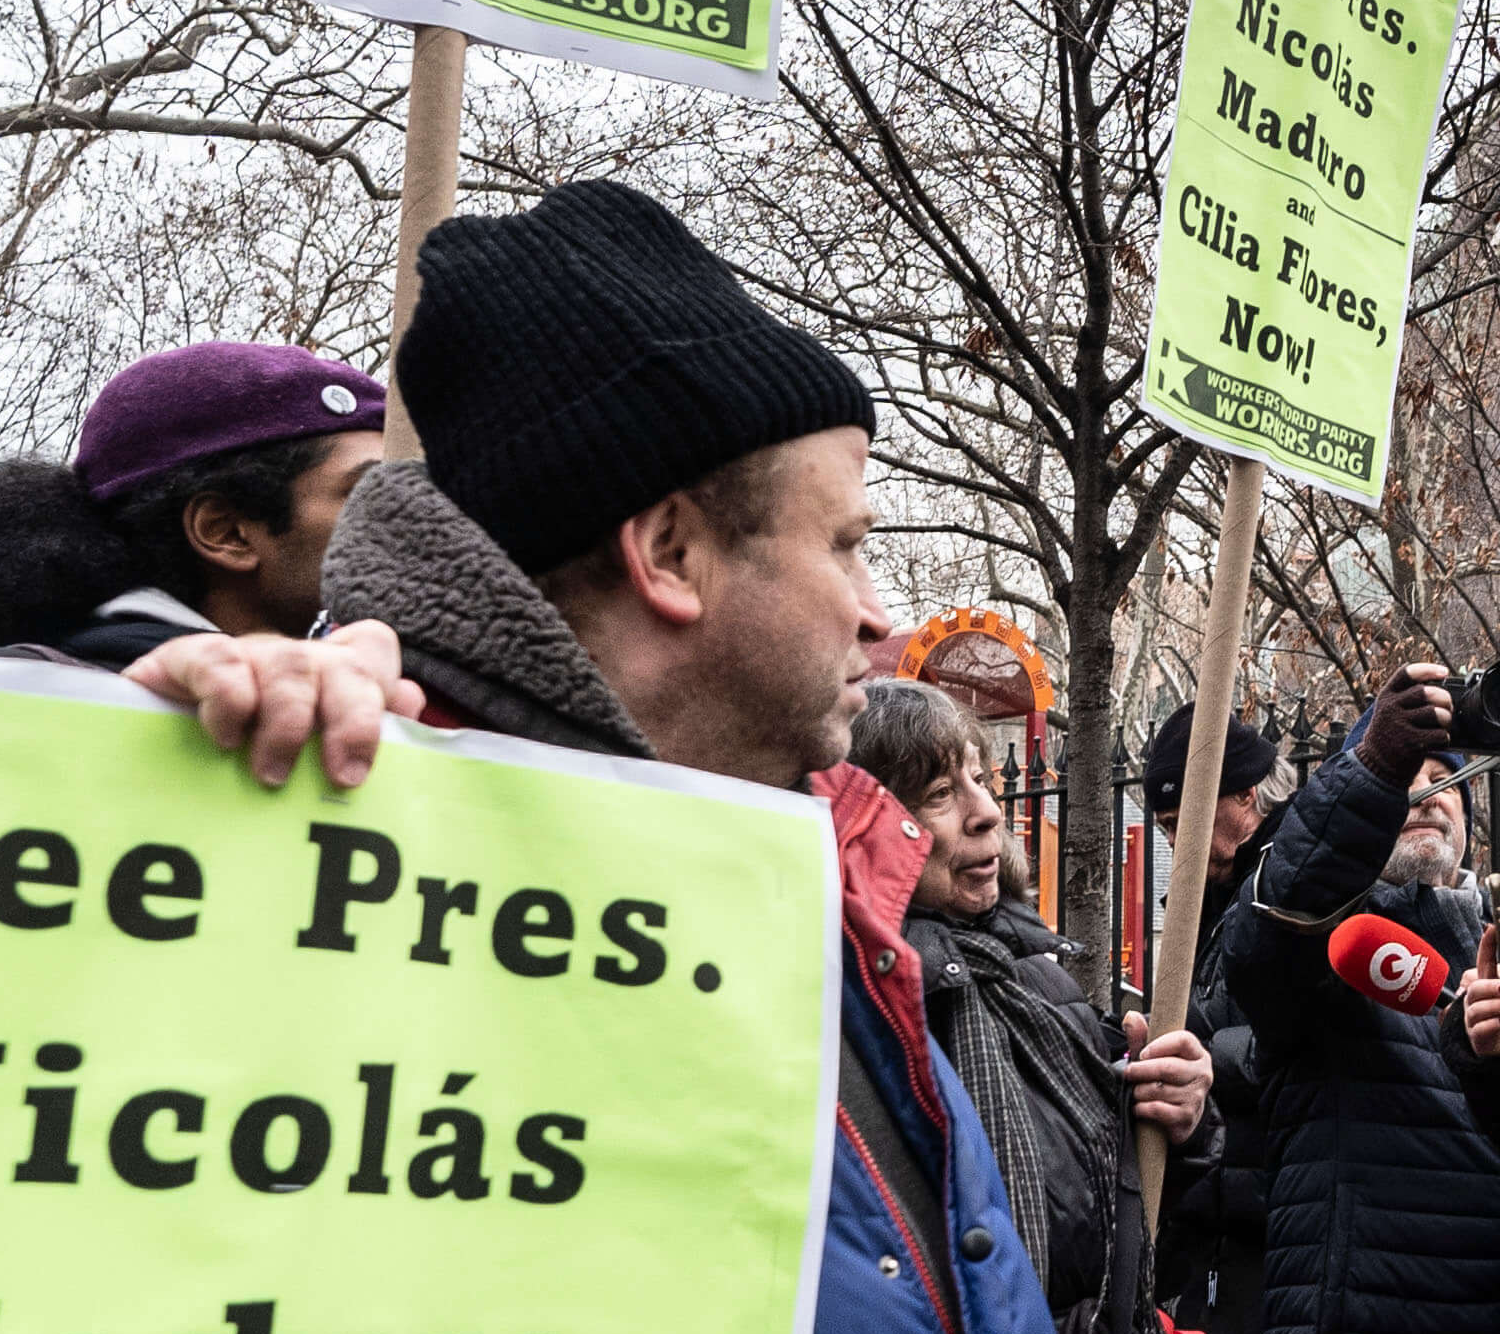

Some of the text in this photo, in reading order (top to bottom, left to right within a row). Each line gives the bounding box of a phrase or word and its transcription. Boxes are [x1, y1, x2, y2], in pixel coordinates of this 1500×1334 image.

[1216, 67, 1365, 200] Maduro
[1286, 194, 1316, 227] and
[1179, 185, 1387, 348] Cilia Flores,
[1219, 295, 1315, 384] Now!
[1207, 370, 1281, 411] WORKERS
[1320, 422, 1367, 450] PARTY
[1216, 394, 1363, 475] WORKERS.ORG
[297, 822, 721, 993] Pres.
